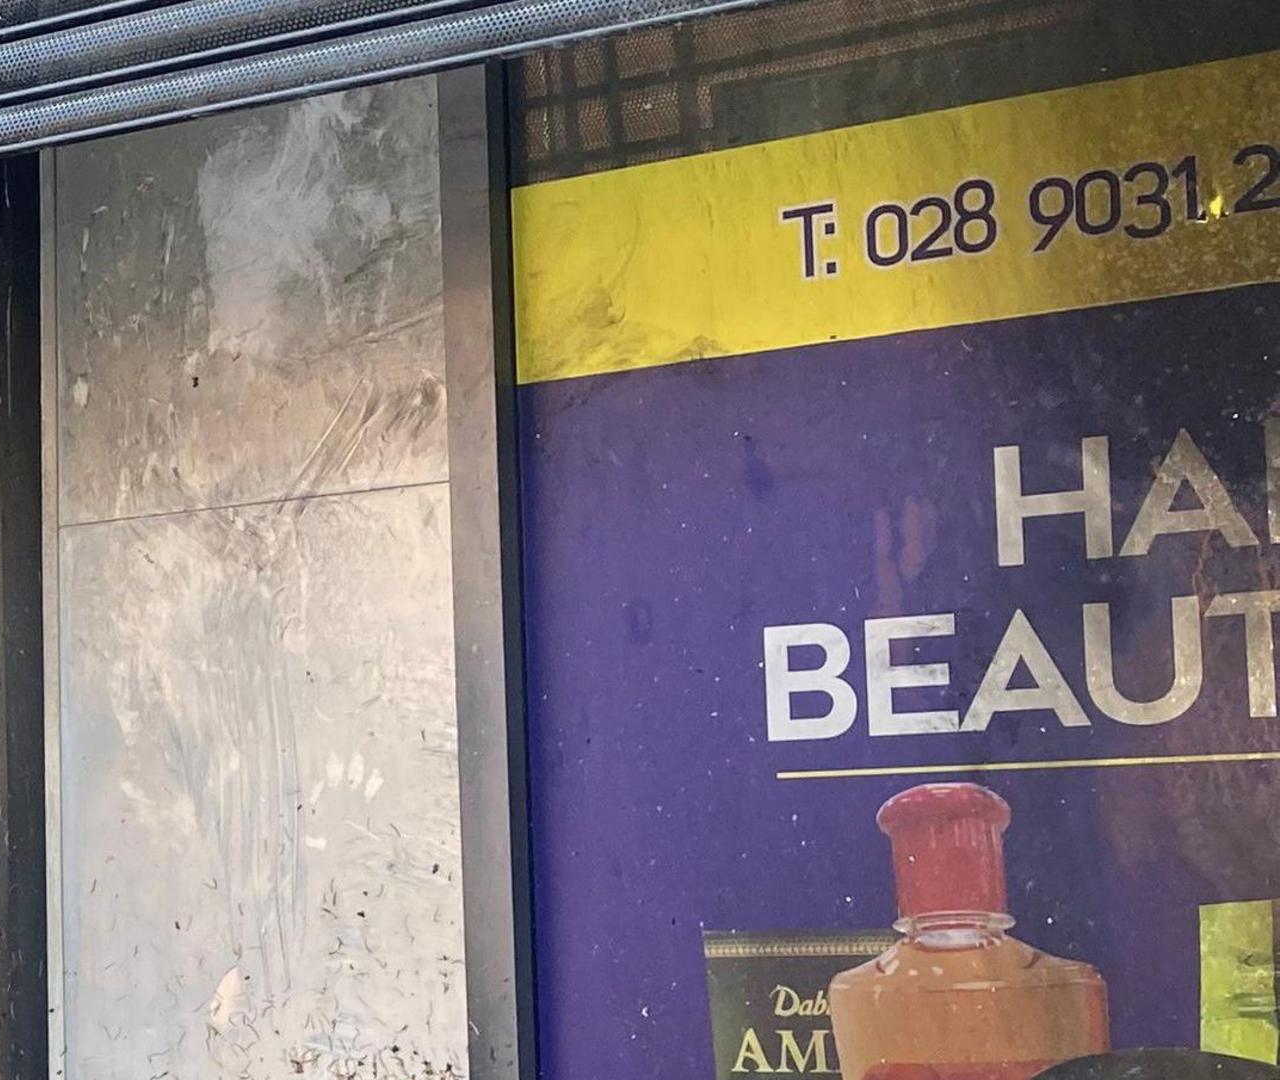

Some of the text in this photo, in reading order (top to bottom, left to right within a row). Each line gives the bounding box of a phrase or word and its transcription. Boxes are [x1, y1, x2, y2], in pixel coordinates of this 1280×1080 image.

[782, 203, 837, 278] T:
[865, 178, 998, 267] 028
[1029, 154, 1206, 252] 9031
[762, 588, 1280, 744] BEAUT
[769, 984, 832, 1017] Dab
[731, 1027, 842, 1074] AM
